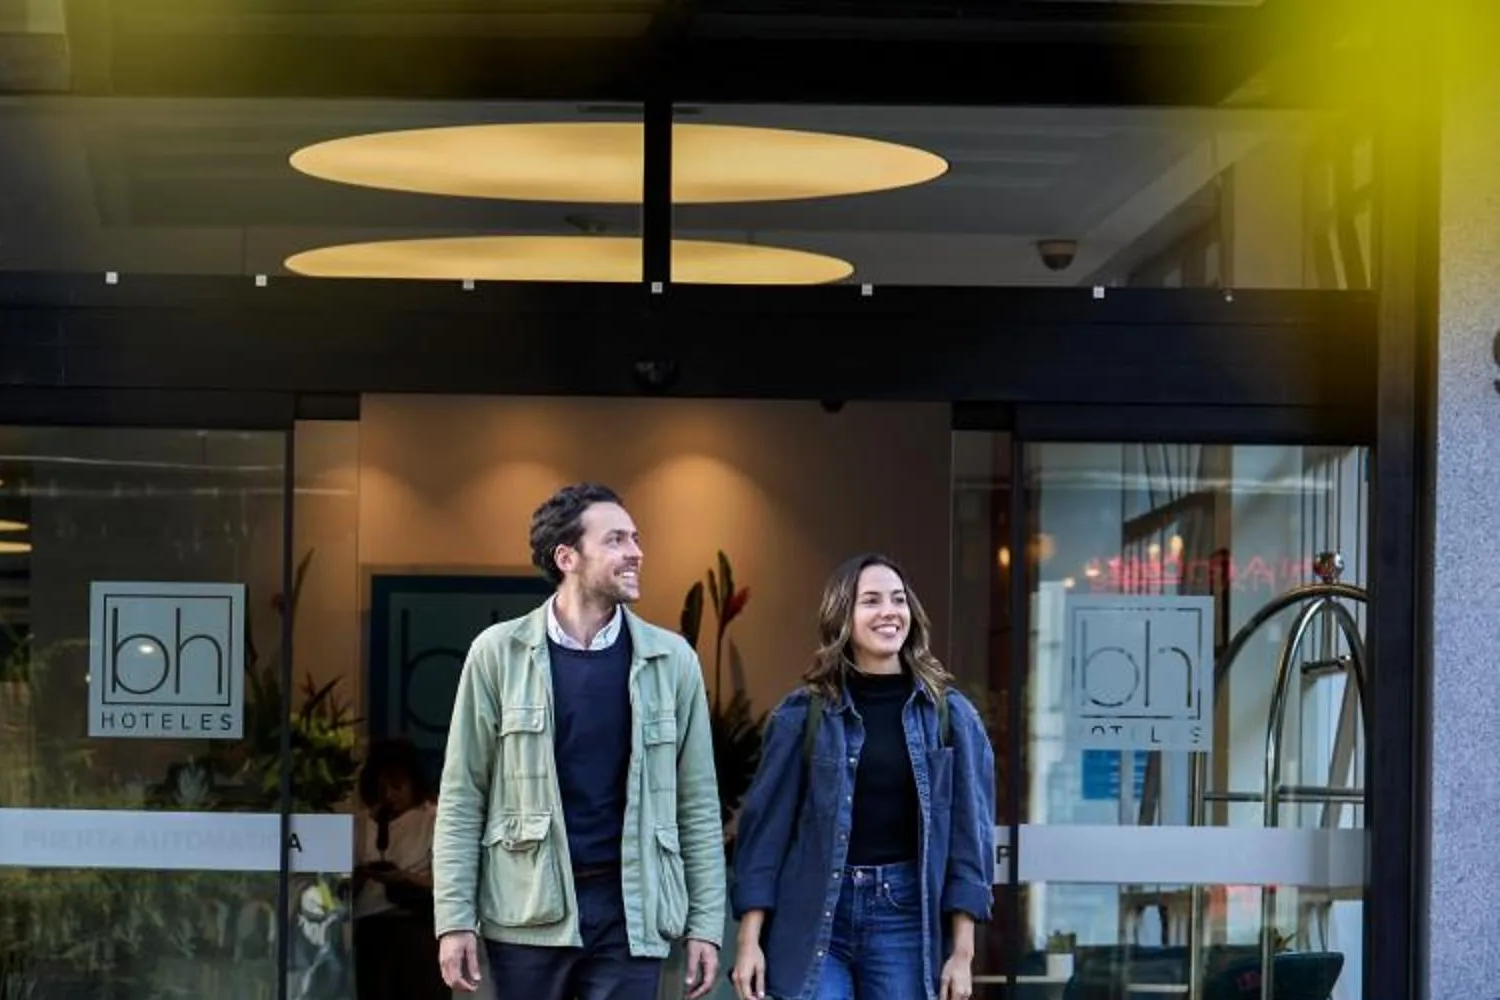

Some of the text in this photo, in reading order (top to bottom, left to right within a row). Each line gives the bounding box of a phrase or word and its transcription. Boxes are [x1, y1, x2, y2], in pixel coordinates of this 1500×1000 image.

[112, 608, 223, 695] bh
[1082, 619, 1192, 708] bh
[101, 712, 234, 730] HOTELES
